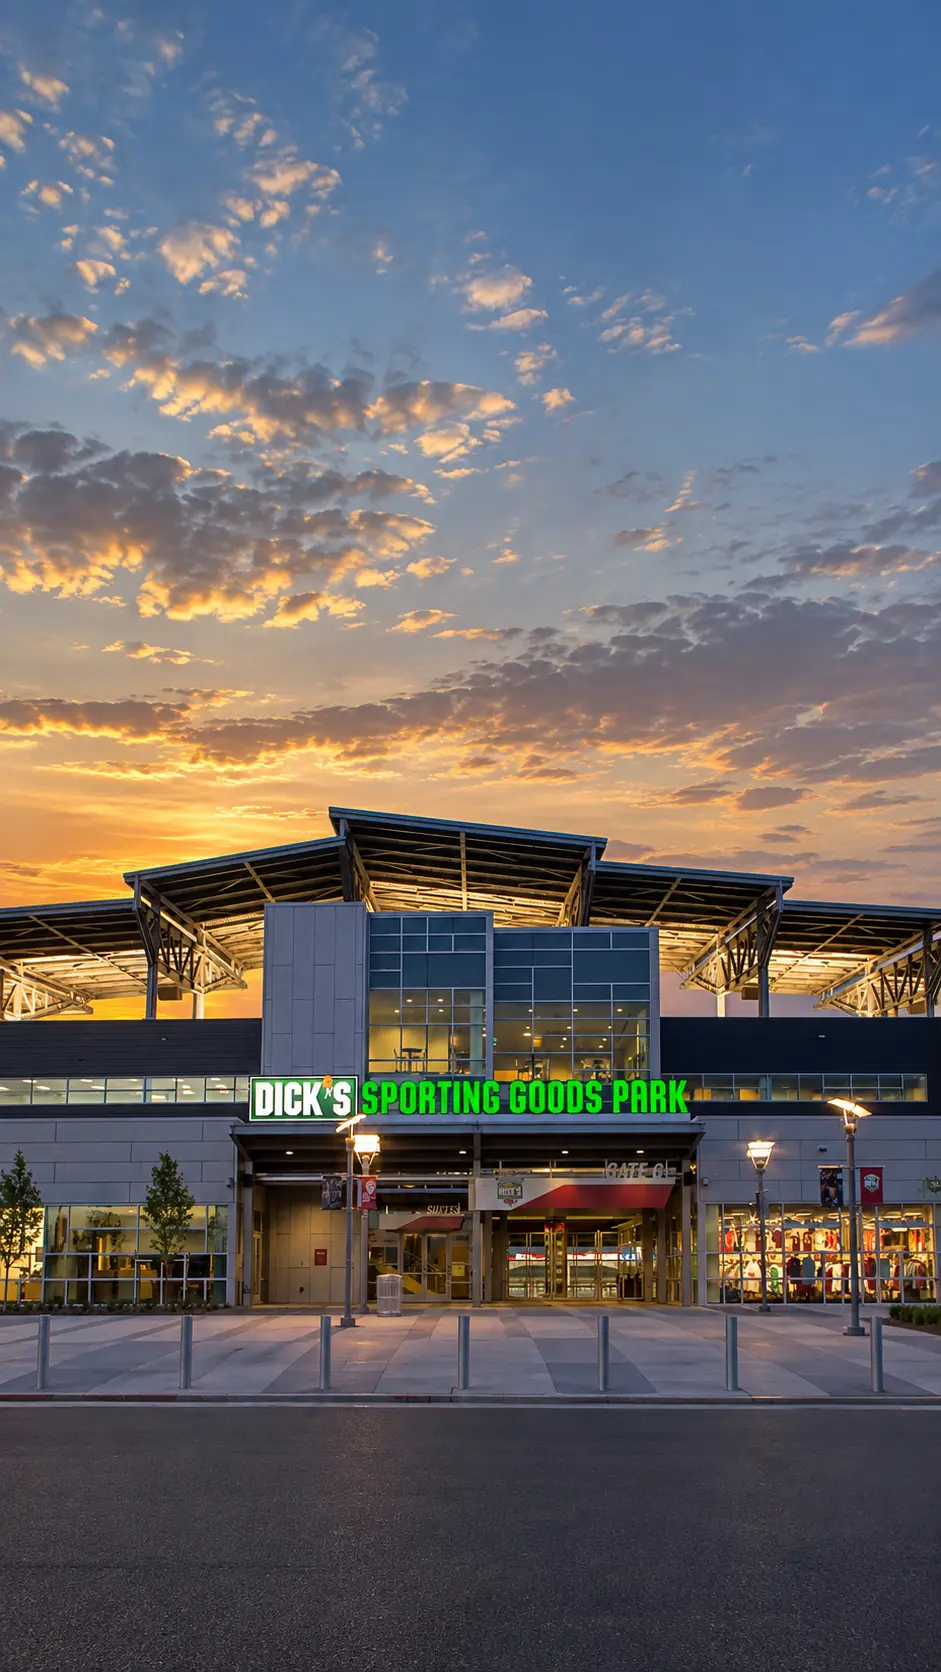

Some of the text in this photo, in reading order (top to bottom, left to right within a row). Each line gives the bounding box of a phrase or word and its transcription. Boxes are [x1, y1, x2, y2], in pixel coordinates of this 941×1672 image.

[254, 1079, 688, 1116] DICK'S SPORTING GOODS PARK
[605, 1162, 648, 1179] GATE
